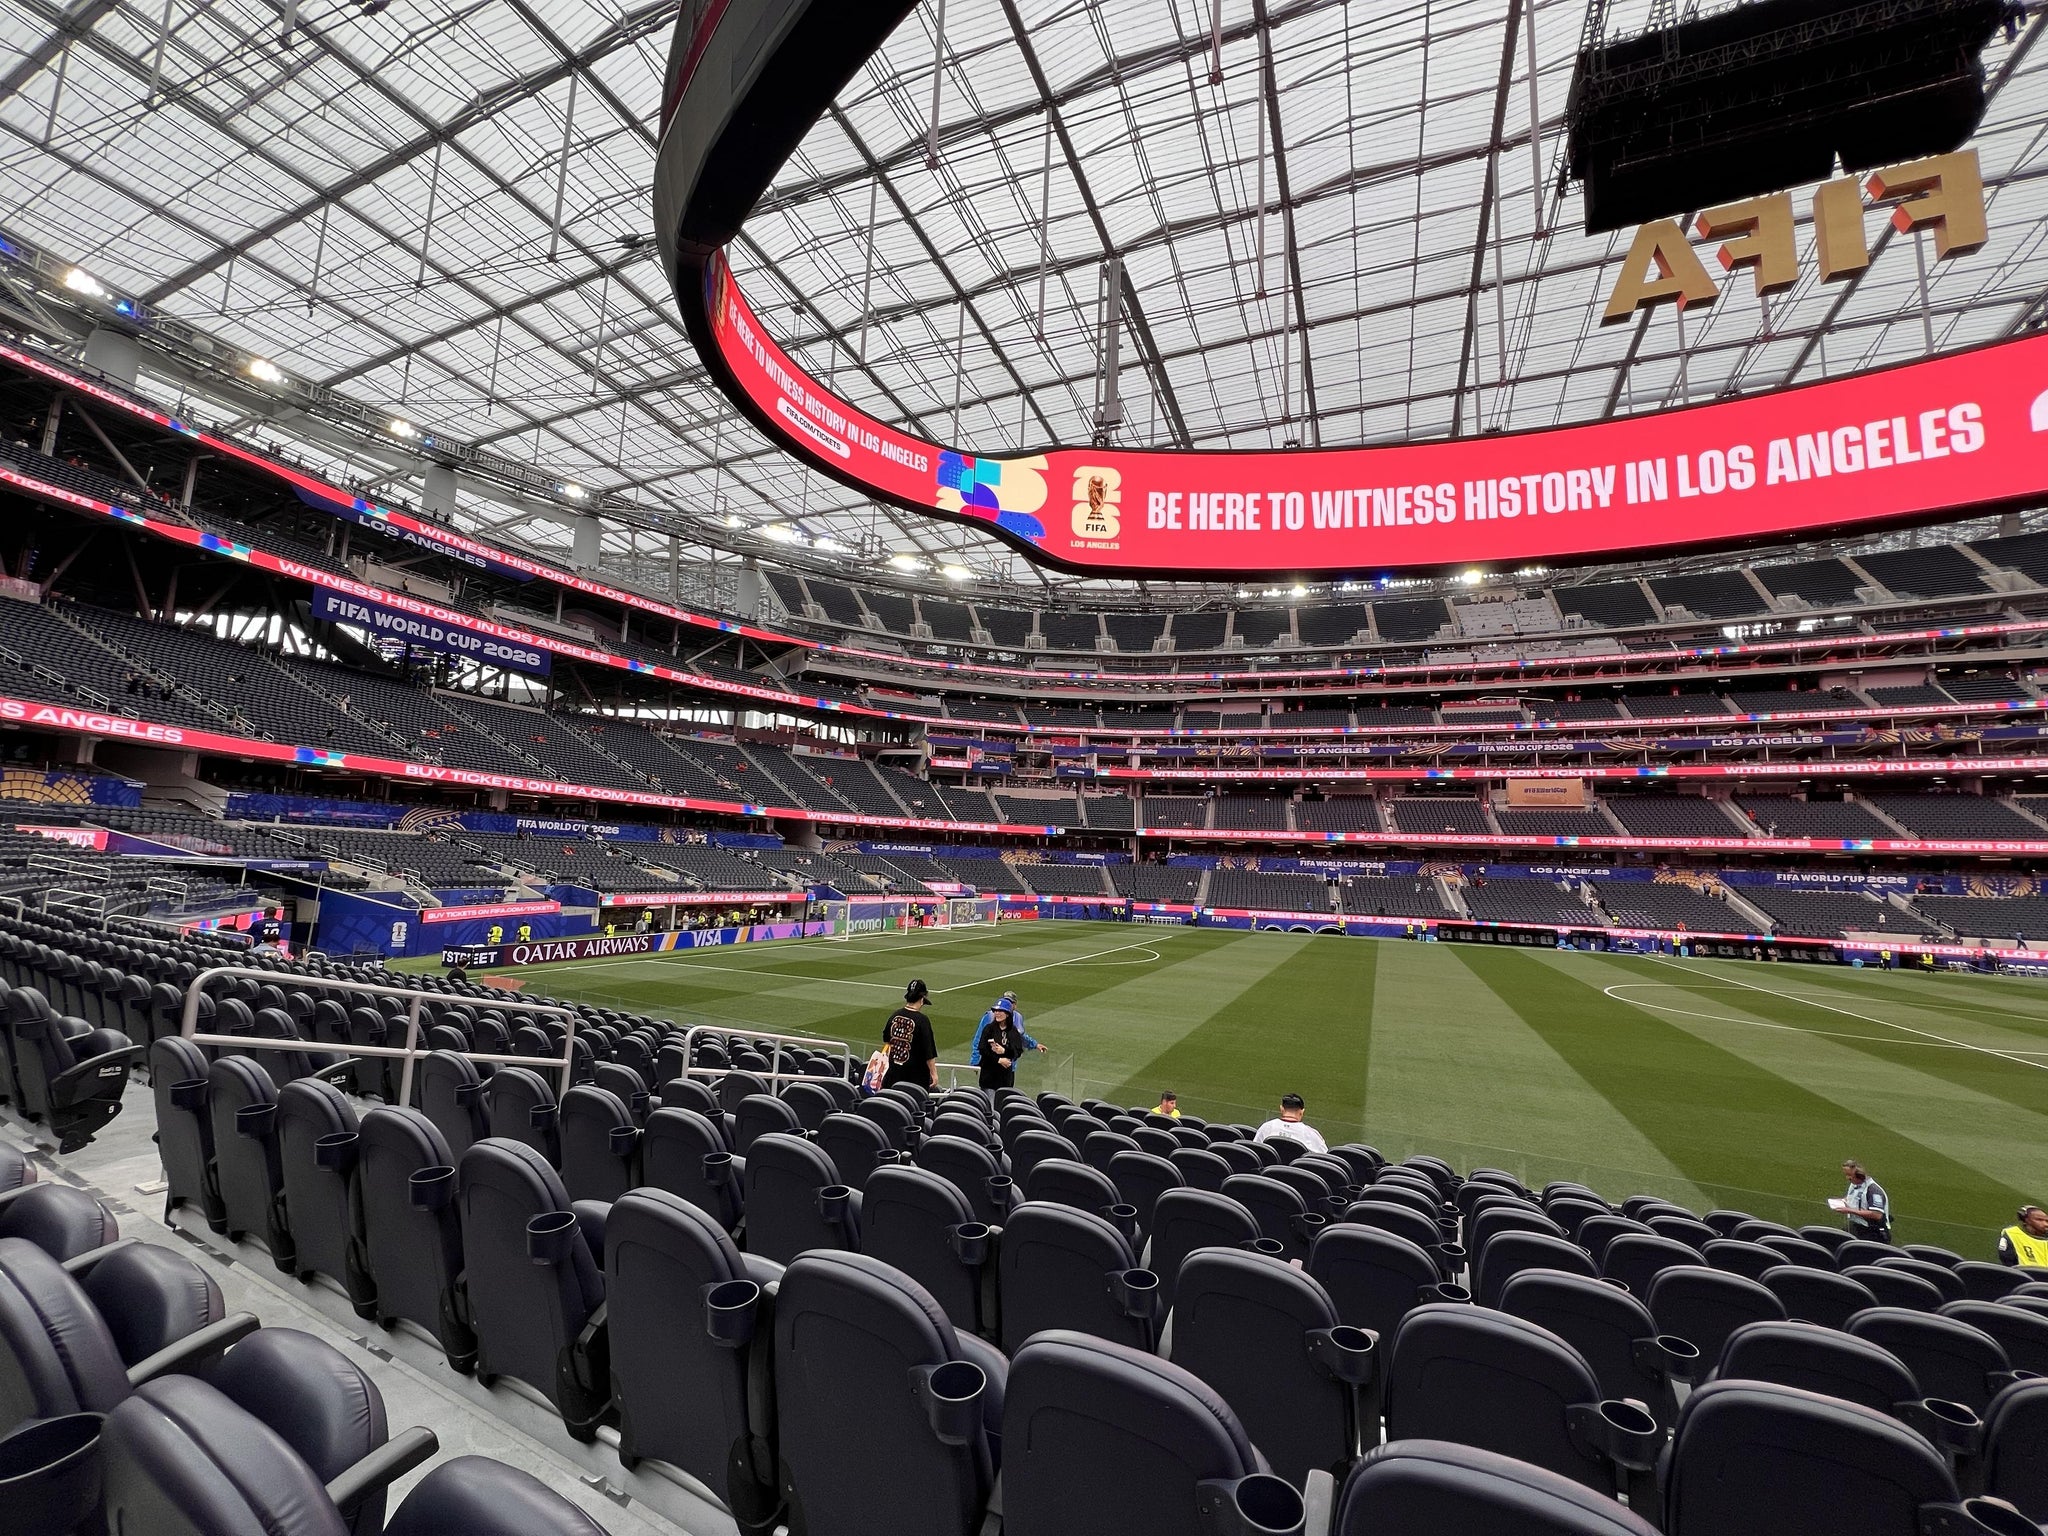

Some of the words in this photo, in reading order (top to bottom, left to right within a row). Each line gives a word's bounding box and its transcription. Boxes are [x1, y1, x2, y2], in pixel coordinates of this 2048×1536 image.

[729, 297, 737, 328] BE
[737, 312, 754, 354] HERE
[755, 339, 765, 367] TO
[765, 353, 805, 406] WITNESS
[805, 392, 846, 433] HISTORY
[848, 422, 859, 441] IN
[860, 429, 880, 452] LOS
[881, 440, 928, 472] ANGELES
[786, 406, 841, 450] FIFA.COM/TICKETS
[1147, 492, 1182, 529] BE
[1189, 493, 1261, 530] HERE
[1268, 491, 1305, 530] TO
[1311, 482, 1456, 529] WITNESS
[1464, 464, 1616, 520] HISTORY
[1625, 458, 1668, 504] IN
[1677, 445, 1756, 499] LOS
[1766, 402, 1985, 485] ANGELES
[1085, 523, 1107, 532] FIFA
[359, 515, 399, 537] LOS
[403, 531, 487, 568] ANGELES
[1070, 540, 1085, 548] LOS
[1087, 541, 1120, 550] ANGELES
[419, 524, 501, 561] WITNESS
[505, 556, 574, 586] HISTORY
[577, 579, 594, 592] IN
[600, 585, 625, 603] LOS
[630, 597, 691, 623] ANGELES
[278, 559, 382, 600] WITNESS
[386, 595, 473, 627] HISTORY
[477, 618, 494, 632] IN
[498, 624, 533, 643] LOS
[536, 635, 610, 664] ANGELES
[327, 596, 371, 624] FIFA
[374, 610, 444, 643] WORLD
[447, 632, 482, 653] CUP
[484, 641, 541, 667] 2026
[671, 670, 800, 704] FIFA.COM/TICKETS
[0, 701, 25, 717] S
[33, 708, 183, 743] ANGELES
[1496, 744, 1525, 752] WORLD
[1746, 737, 1824, 745] ANGELES
[1151, 770, 1204, 778] WITNESS
[1206, 770, 1259, 778] HISTORY
[1262, 770, 1274, 778] IN
[1276, 770, 1304, 778] LOS
[1307, 770, 1367, 778] ANGELES
[1475, 768, 1606, 777] FIFA.COM/TICKETS
[1724, 766, 1800, 774] WITNESS
[1803, 764, 1881, 772] HISTORY
[1908, 761, 1948, 769] LOS
[1952, 760, 2048, 768] ANGELES
[405, 765, 445, 779] BUY
[451, 772, 523, 788] TICKETS
[528, 780, 552, 791] ON
[555, 783, 687, 806] FIFA.COM/TICKETS
[517, 820, 537, 829] FIFA
[538, 821, 571, 831] WORLD
[591, 825, 619, 834] 2026
[806, 812, 856, 822] WITNESS
[859, 816, 907, 826] HISTORY
[909, 820, 920, 828] IN
[922, 821, 947, 829] LOS
[949, 823, 998, 831] ANGELES
[892, 844, 931, 852] ANGELES
[1801, 874, 1840, 882] WORLD
[1843, 875, 1864, 883] CUP
[1867, 876, 1908, 884] 2026
[752, 894, 788, 902] ANGELES
[446, 909, 477, 918] TICKETS
[491, 904, 555, 914] FIFA.COM/TICKETS
[1211, 915, 1228, 923] FIFA
[693, 930, 722, 947] VISA
[512, 942, 577, 965] QATAR
[584, 936, 649, 957] AIRWAYS
[2005, 951, 2040, 959] LOS
